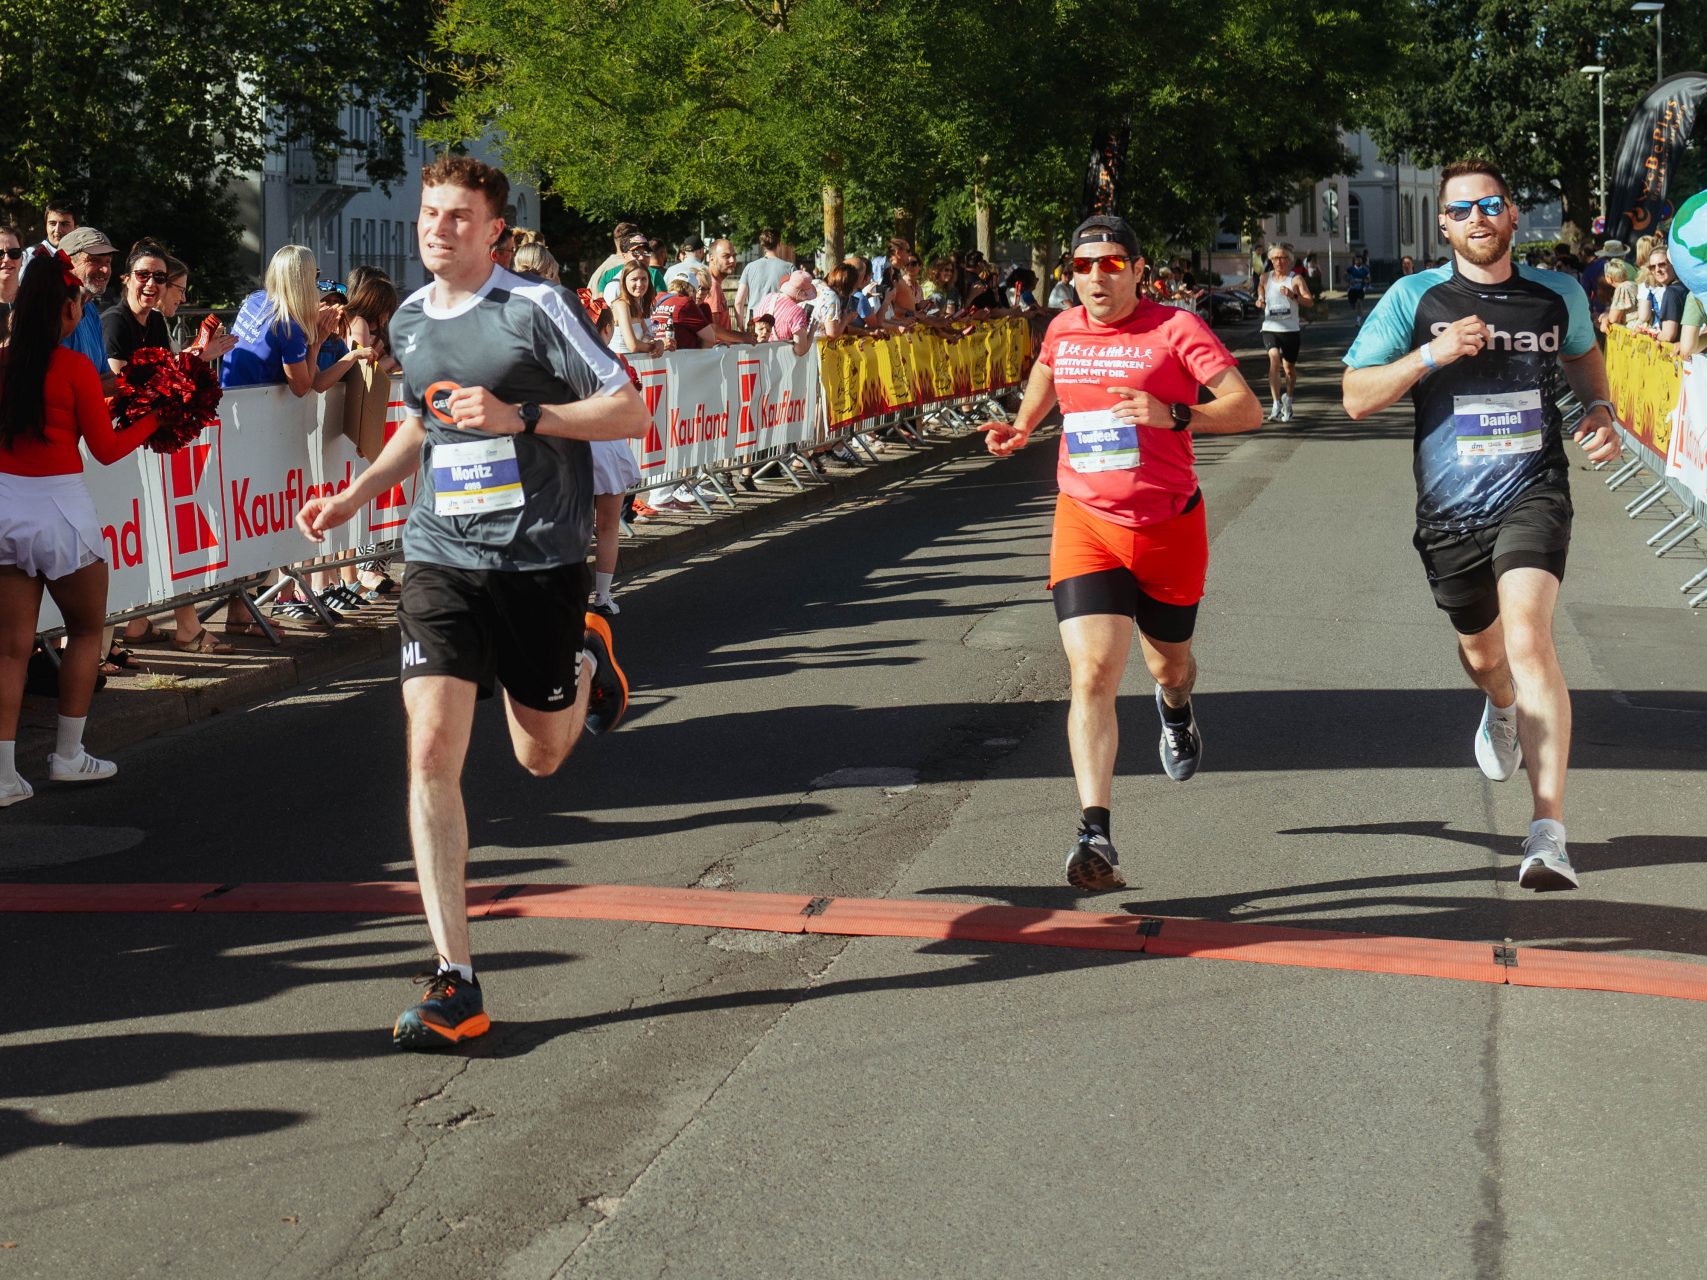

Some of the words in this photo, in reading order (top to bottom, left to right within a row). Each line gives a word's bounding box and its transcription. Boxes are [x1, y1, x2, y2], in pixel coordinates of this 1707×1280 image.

[1430, 321, 1560, 352] Shad
[1064, 367, 1089, 376] TEAM
[1090, 368, 1107, 377] MIT
[1109, 369, 1128, 378] DIR.
[670, 400, 729, 448] Kaufland
[1480, 412, 1521, 426] Daniel
[451, 465, 493, 481] Moritz
[402, 641, 427, 670] ML
